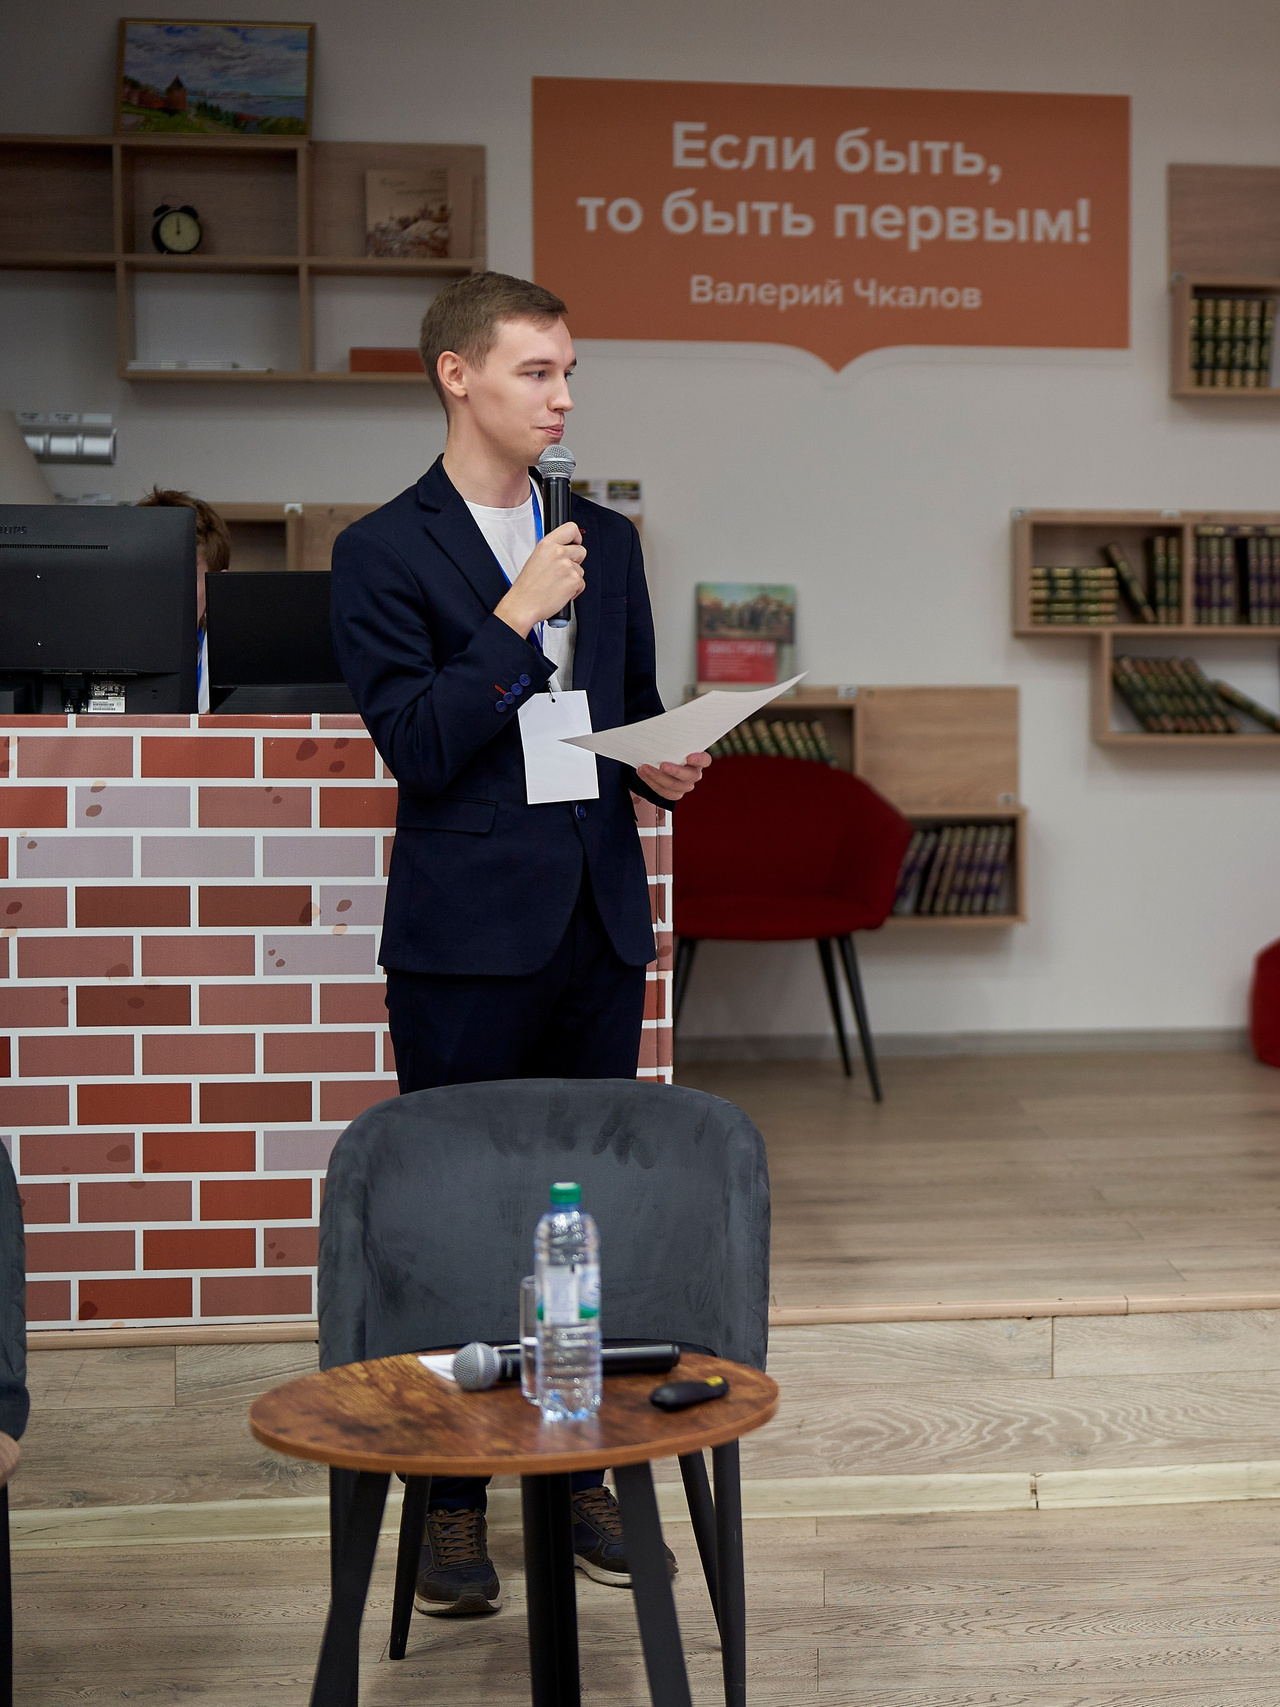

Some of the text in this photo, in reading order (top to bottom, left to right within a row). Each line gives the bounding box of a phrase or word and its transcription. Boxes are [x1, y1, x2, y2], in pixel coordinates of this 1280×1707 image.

[671, 120, 1002, 185] Если быть,
[576, 187, 1091, 252] то быть первым!
[689, 274, 983, 312] Валерий Чкалов
